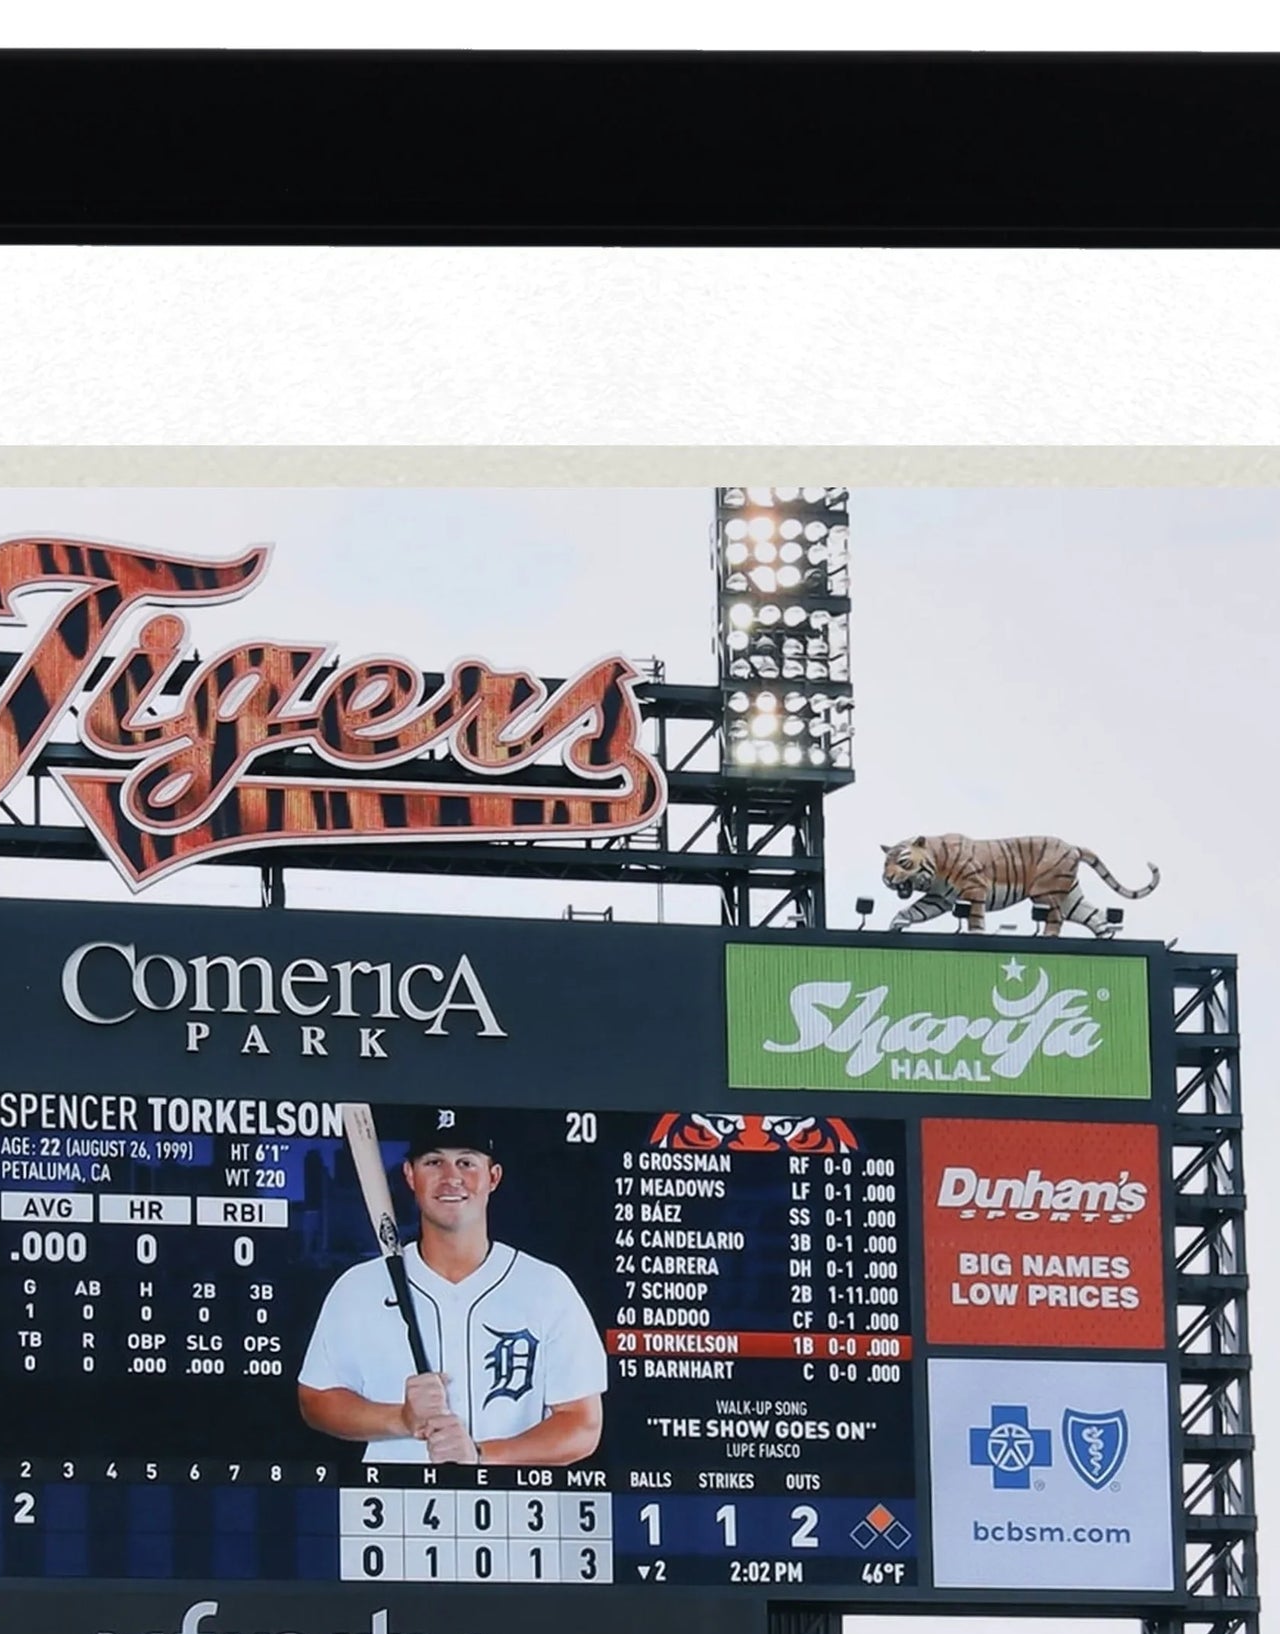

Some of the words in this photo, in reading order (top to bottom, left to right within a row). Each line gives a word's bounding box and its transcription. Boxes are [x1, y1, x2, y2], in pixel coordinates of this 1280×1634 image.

[763, 966, 1105, 1080] Sharifa
[186, 1022, 393, 1059] PARK
[892, 1057, 990, 1083] HALAL
[0, 1092, 138, 1132] SPENCER
[148, 1096, 343, 1136] TORKELSON
[1, 1138, 36, 1156] AGE:
[40, 1139, 61, 1157] 22
[67, 1139, 126, 1159] (AUGUST
[131, 1141, 151, 1160] 26,
[156, 1141, 194, 1161] 1999)
[1, 1162, 86, 1183] PETALUMA,
[91, 1164, 111, 1183] CA
[639, 1153, 731, 1173] GROSSMAN
[641, 1178, 725, 1198] MEADOWS
[937, 1166, 1147, 1213] Dunham's
[20, 1198, 73, 1218] AVG
[129, 1200, 163, 1221] HR
[223, 1203, 264, 1223] RBI
[641, 1201, 682, 1222] BÁEZ
[959, 1210, 1133, 1224] SPORTS
[641, 1231, 744, 1250] CANDELARIO
[641, 1256, 719, 1275] CABRERA
[959, 1253, 1011, 1275] BIG
[1023, 1255, 1130, 1279] NAMES
[642, 1282, 708, 1301] SCHOOP
[952, 1282, 1018, 1306] LOW
[1028, 1285, 1139, 1309] PRICES
[644, 1308, 710, 1326] BADDOO
[645, 1334, 738, 1354] TORKELSON
[645, 1360, 734, 1379] BARNHART
[716, 1401, 772, 1415] WALK-UP
[775, 1401, 807, 1416] SONG
[706, 1420, 769, 1438] SHOW
[776, 1421, 830, 1439] GOES
[726, 1444, 755, 1458] LUPE
[759, 1444, 800, 1459] FIASCO
[630, 1472, 672, 1488] BALLS
[699, 1473, 754, 1490] STRIKES
[786, 1474, 820, 1490] OUTS
[973, 1520, 1131, 1544] bcbsm.com
[730, 1561, 770, 1581] 2:02
[774, 1562, 803, 1582] PM
